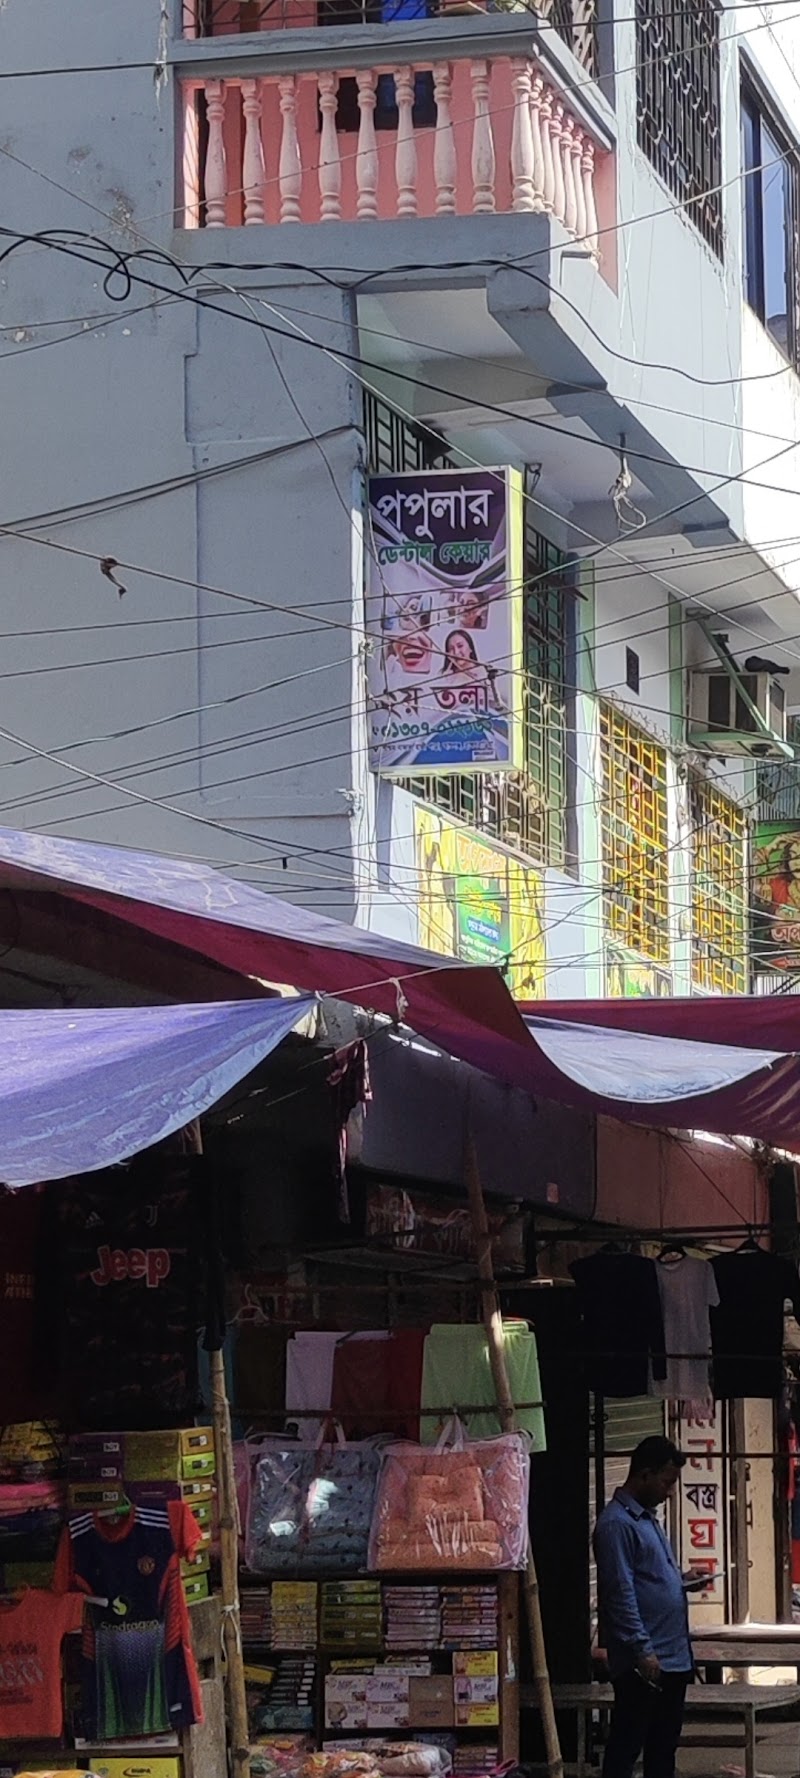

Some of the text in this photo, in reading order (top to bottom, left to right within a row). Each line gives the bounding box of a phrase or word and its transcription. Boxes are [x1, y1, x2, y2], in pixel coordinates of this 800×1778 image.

[376, 485, 495, 540] পপুলার
[378, 539, 437, 567] ডেন্টাল
[429, 685, 489, 713] তলা
[90, 1244, 171, 1288] Jeep
[683, 1483, 718, 1513] বস্ত্র
